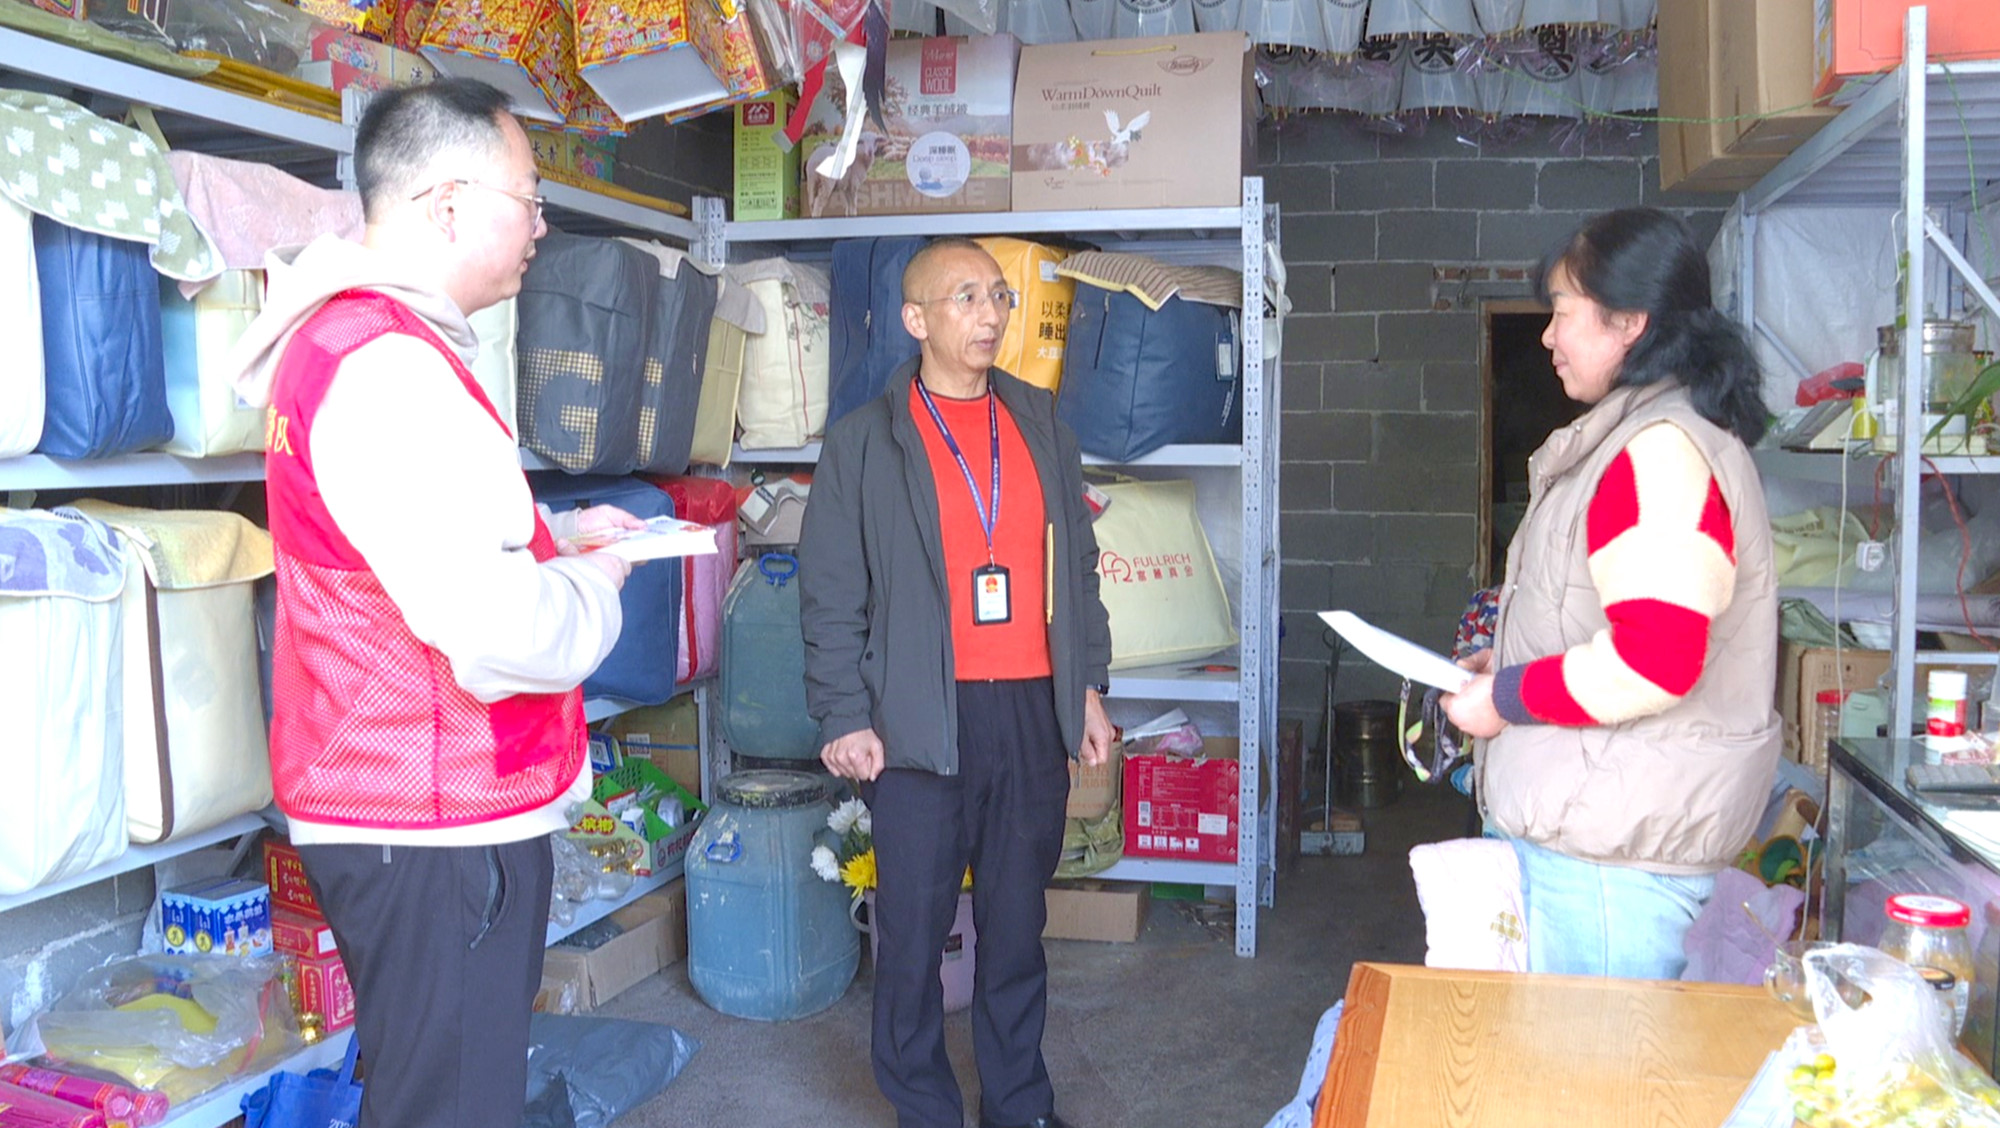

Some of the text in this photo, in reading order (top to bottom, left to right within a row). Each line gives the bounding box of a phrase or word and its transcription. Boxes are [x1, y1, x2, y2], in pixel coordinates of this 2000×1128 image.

[925, 67, 953, 78] CLASSIC
[925, 78, 952, 93] WOOL
[1041, 299, 1071, 320] 以柔
[1039, 321, 1066, 342] 睡出
[1132, 552, 1191, 568] FULLRICH
